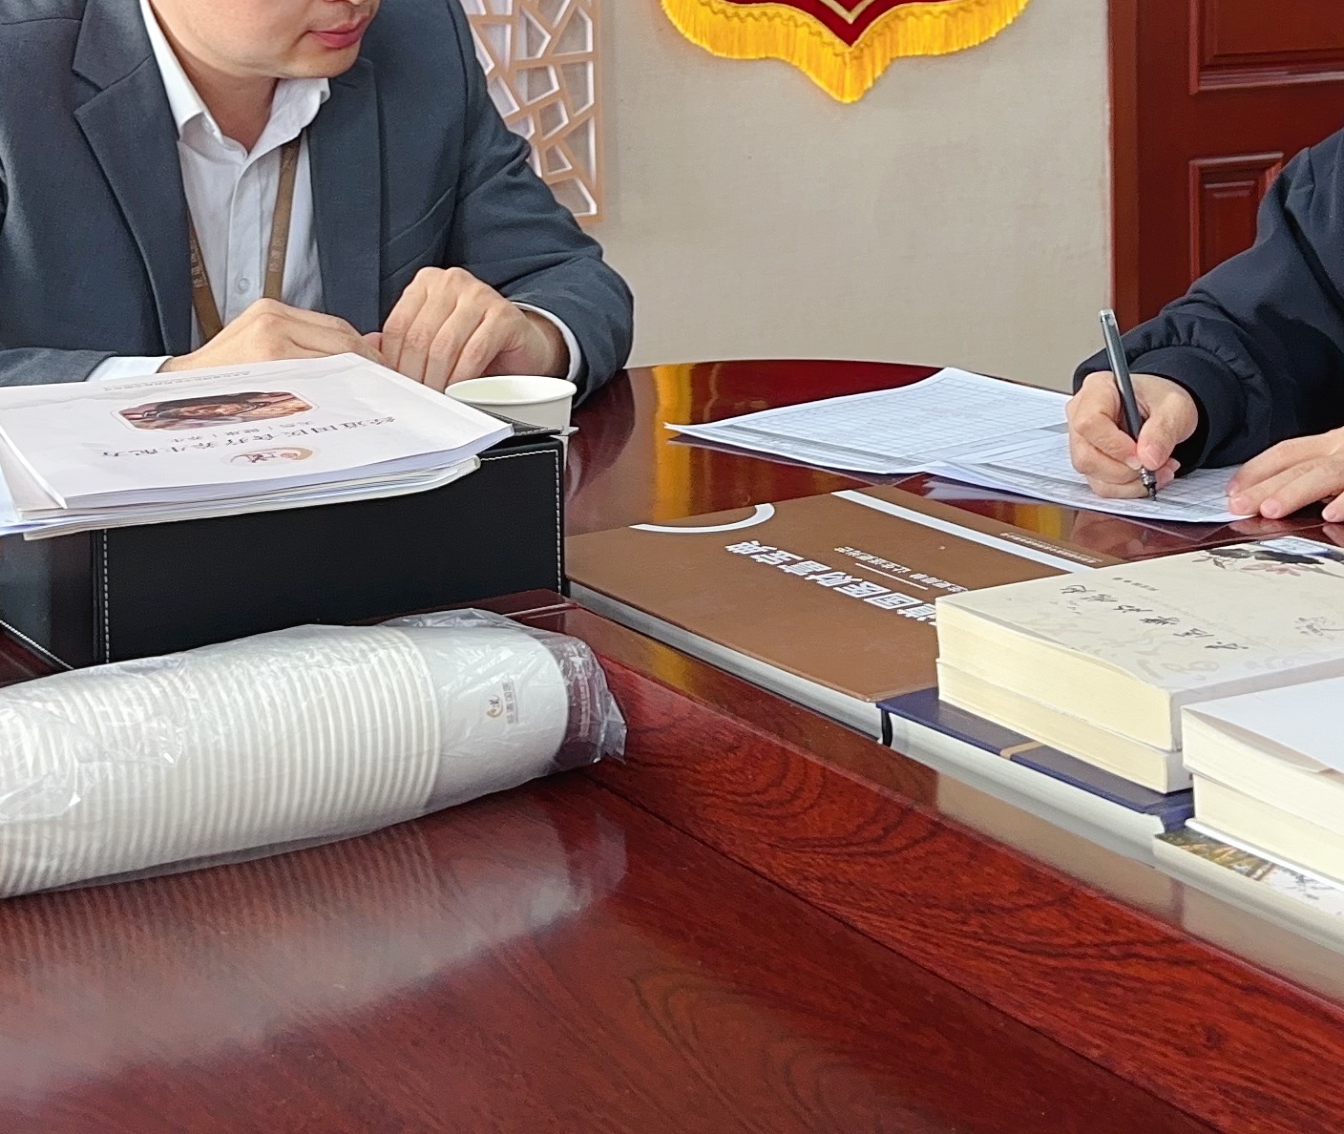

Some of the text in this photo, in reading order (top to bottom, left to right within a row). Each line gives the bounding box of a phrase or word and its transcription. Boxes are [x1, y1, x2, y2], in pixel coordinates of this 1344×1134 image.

[724, 540, 939, 626] 道国医财富宝典
